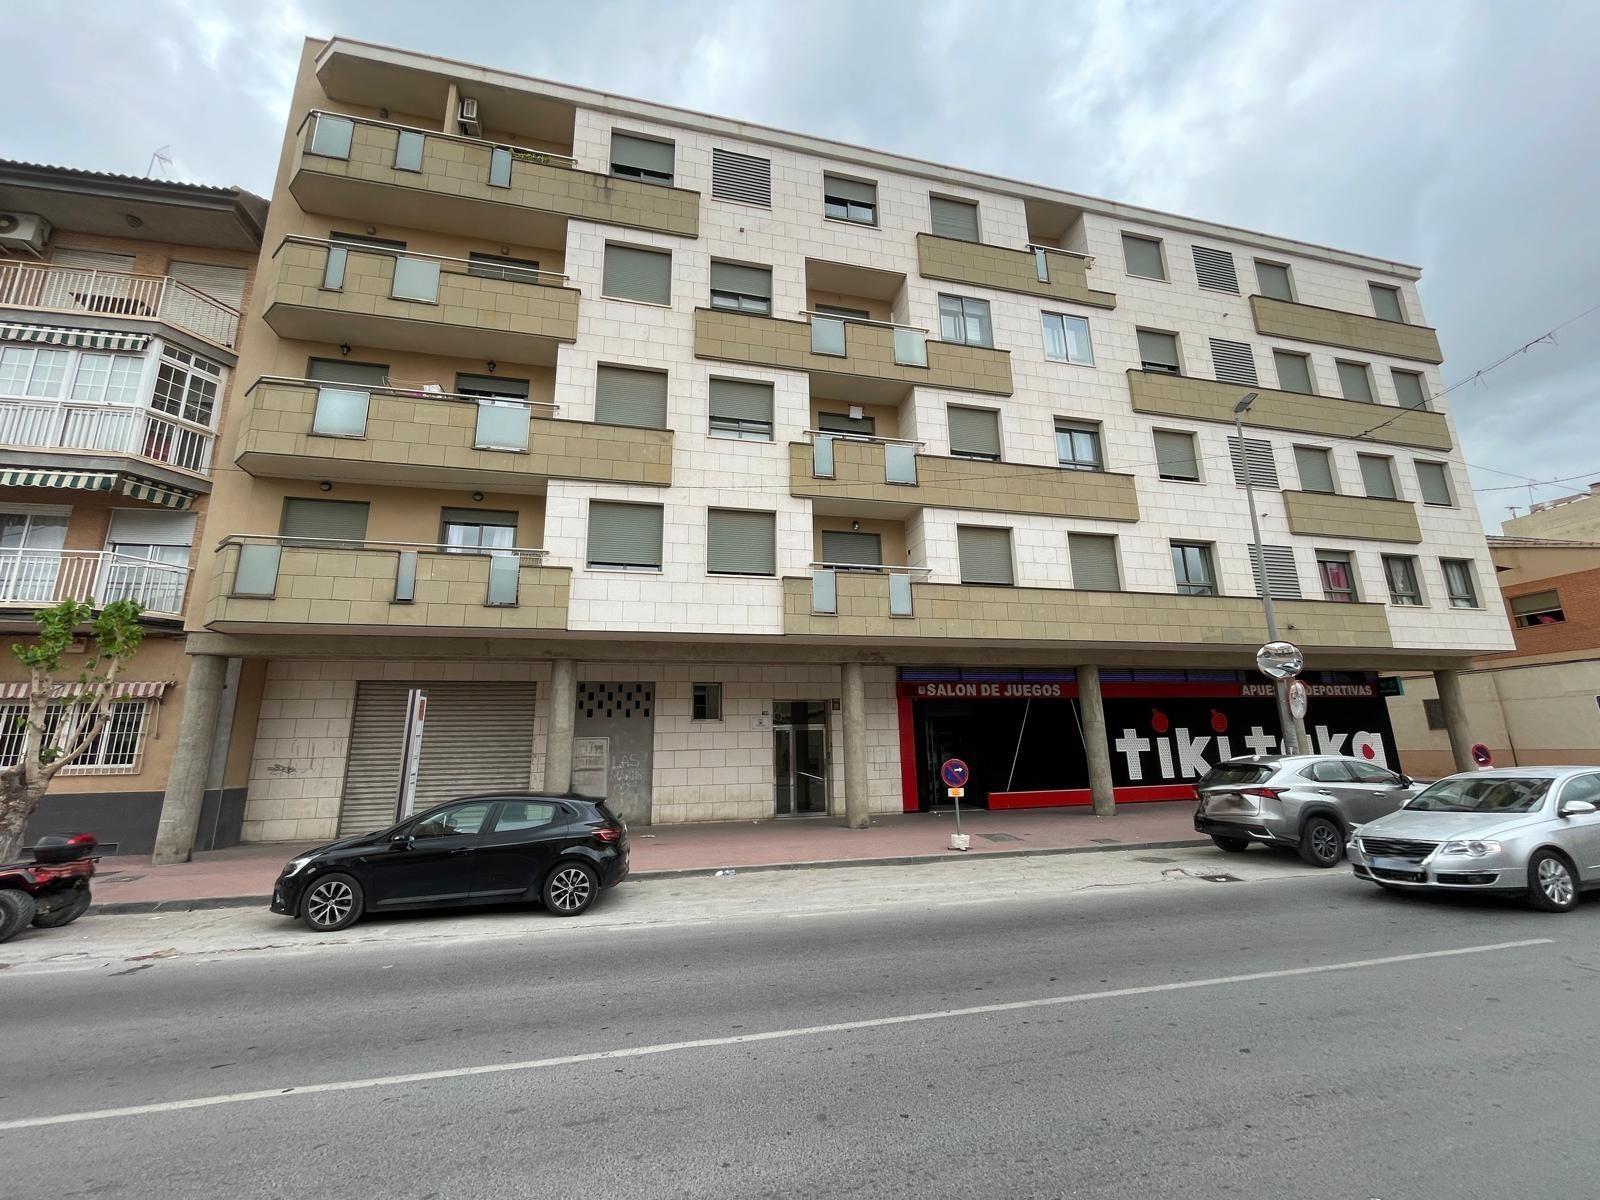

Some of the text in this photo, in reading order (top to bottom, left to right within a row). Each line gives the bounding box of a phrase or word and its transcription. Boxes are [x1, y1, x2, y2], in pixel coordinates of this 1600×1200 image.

[927, 684, 1061, 696] SALON DE JUEGOS
[1306, 685, 1373, 696] DEPORTIVAS
[1115, 708, 1231, 780] tiki
